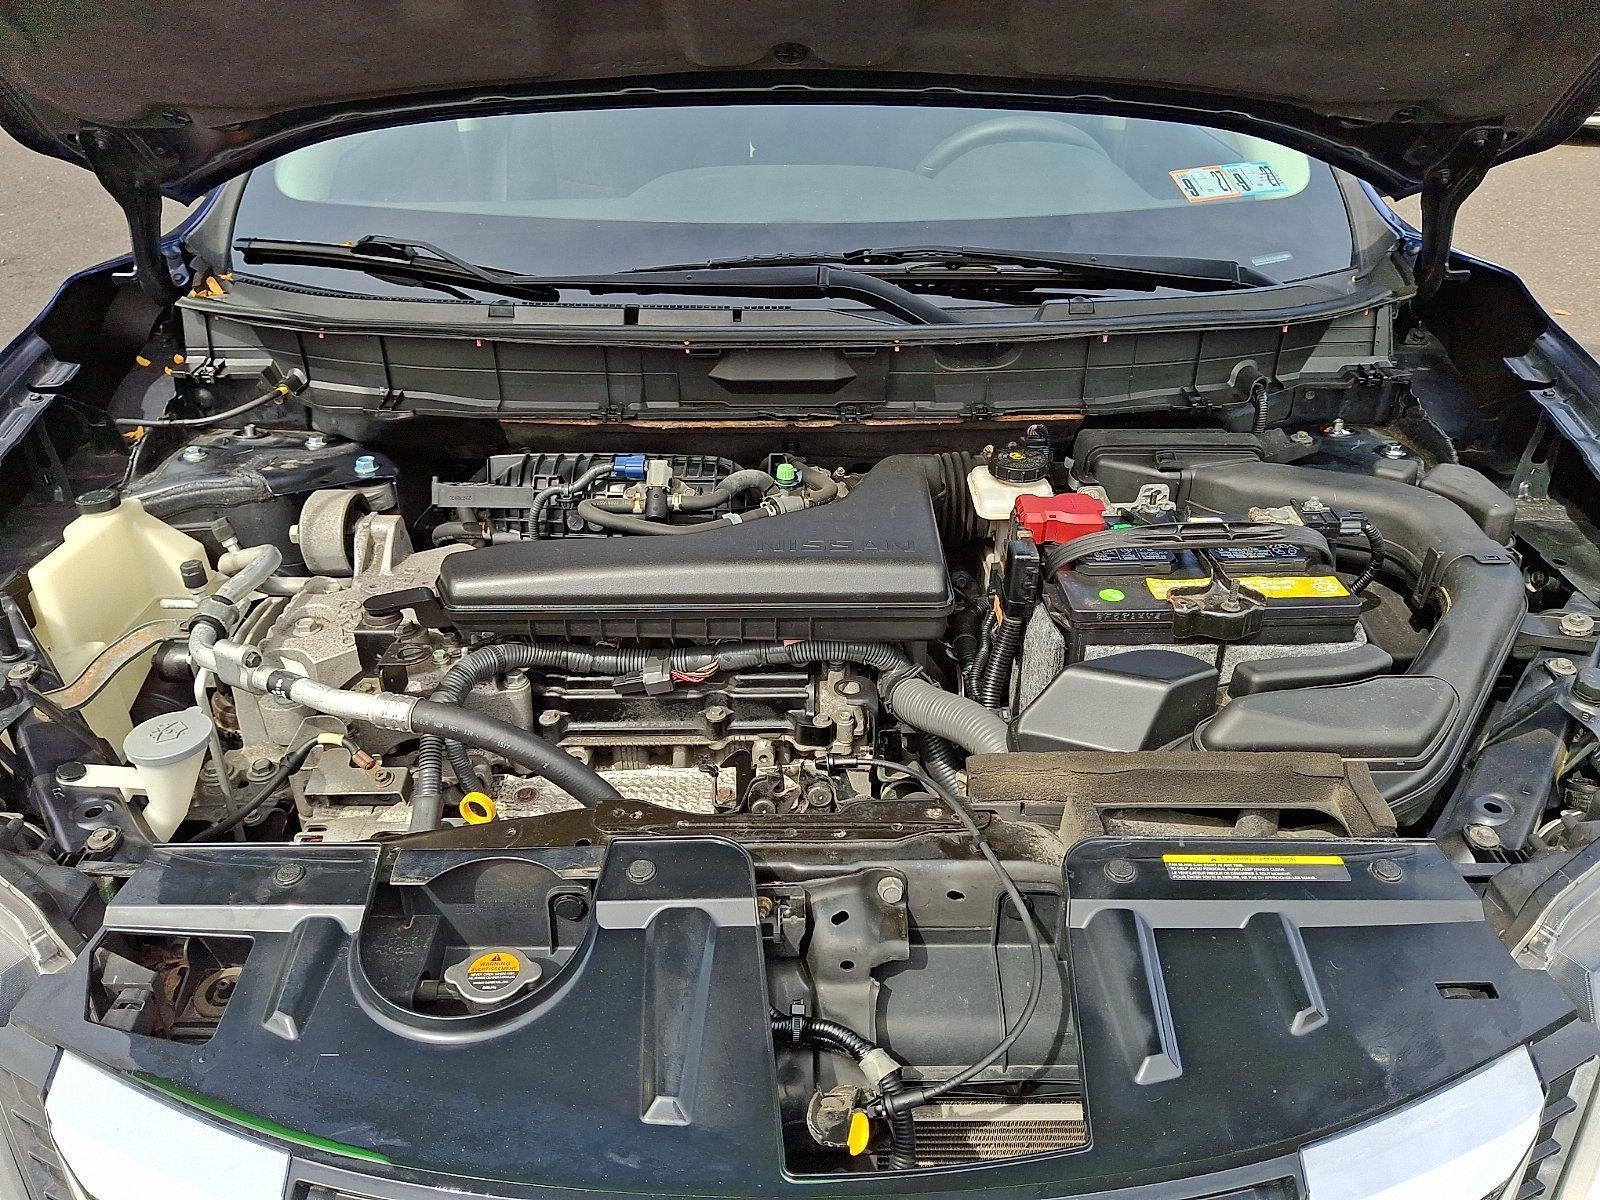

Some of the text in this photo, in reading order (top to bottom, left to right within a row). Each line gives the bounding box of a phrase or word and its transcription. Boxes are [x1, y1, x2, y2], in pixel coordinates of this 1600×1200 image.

[1182, 170, 1232, 197] 9 27
[1233, 172, 1251, 192] 9
[756, 539, 917, 552] NISSAN
